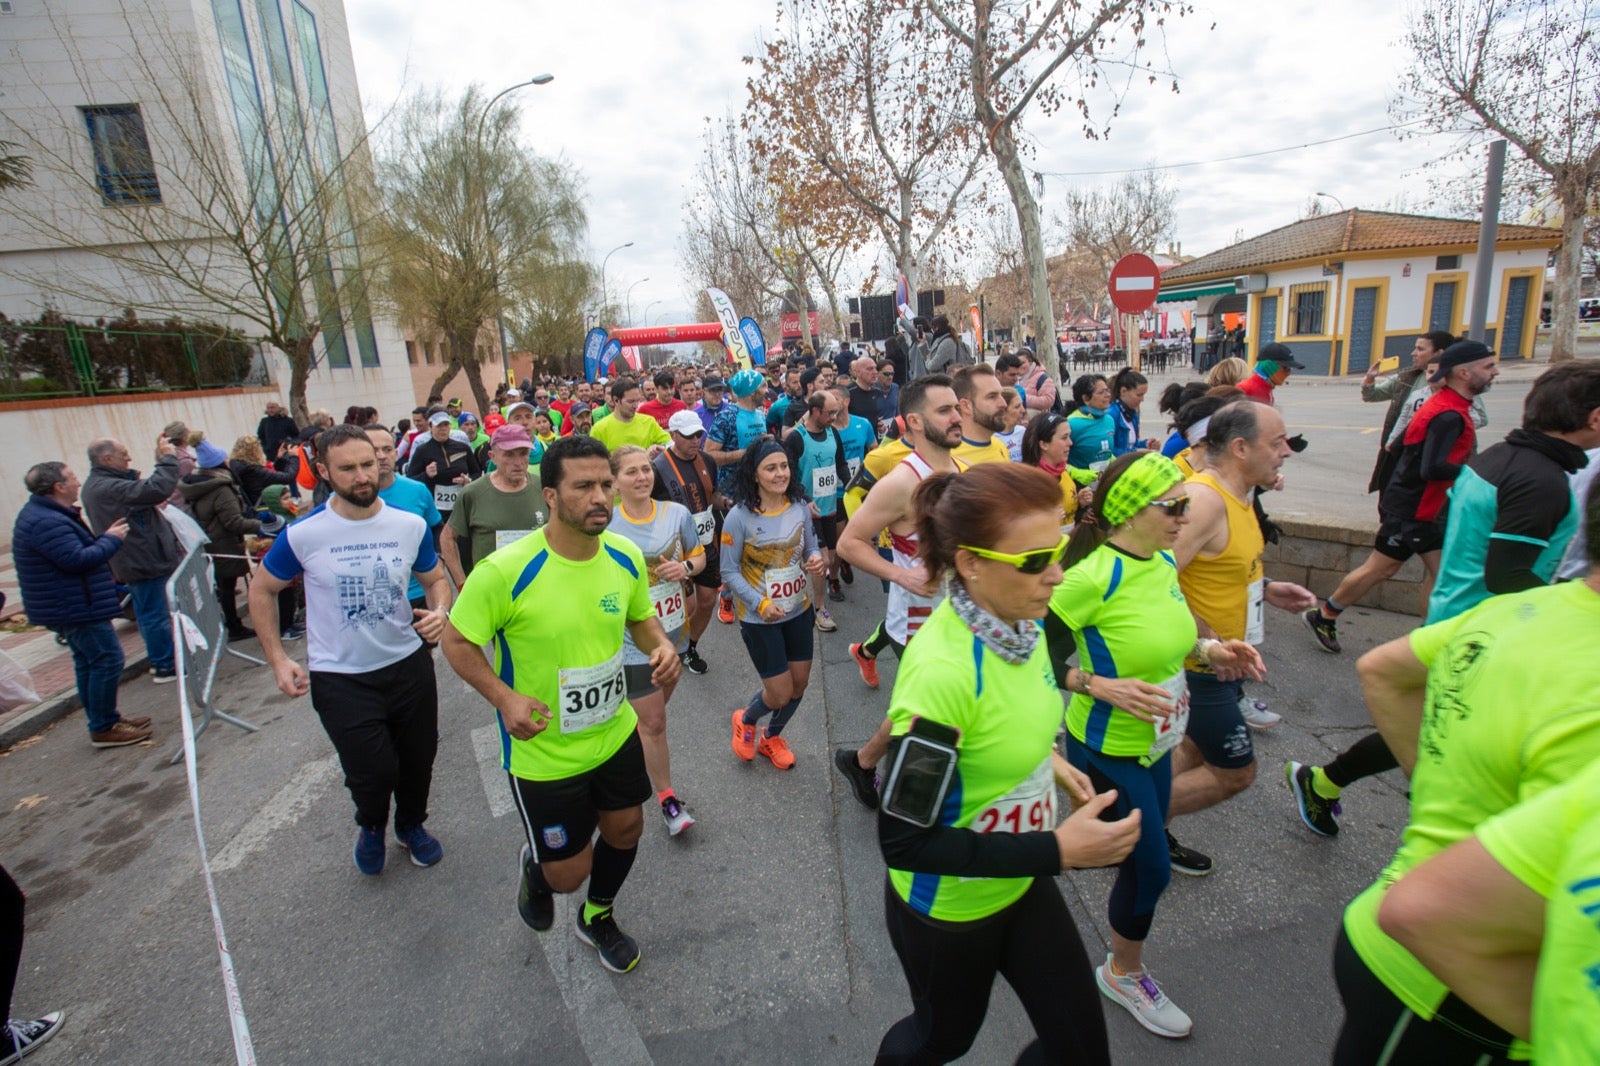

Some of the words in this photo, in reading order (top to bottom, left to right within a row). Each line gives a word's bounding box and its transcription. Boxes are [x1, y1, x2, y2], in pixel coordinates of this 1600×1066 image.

[818, 475, 835, 487] 869
[437, 493, 457, 502] 220
[330, 546, 343, 554] XVII
[343, 543, 369, 552] PRUEBA
[771, 574, 807, 599] 2005
[566, 671, 624, 714] 3078
[978, 791, 1053, 834] 2191
